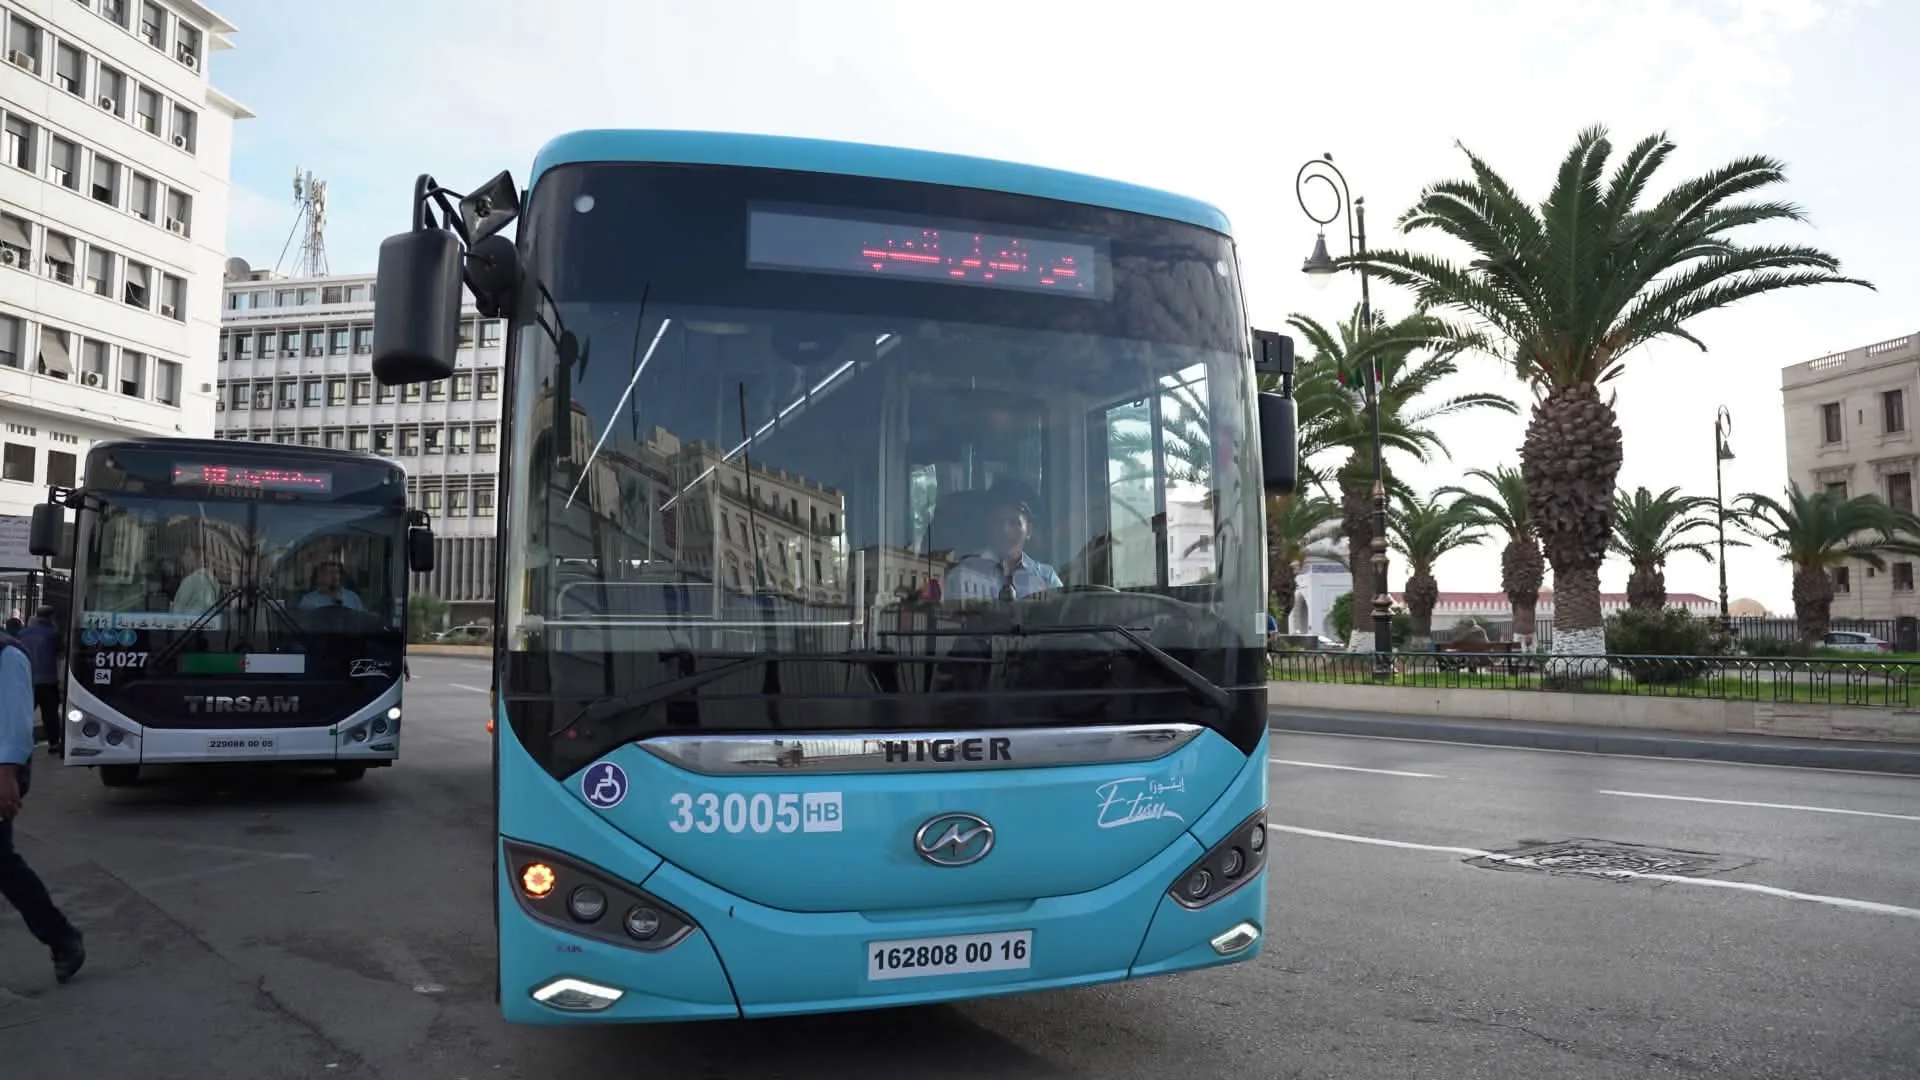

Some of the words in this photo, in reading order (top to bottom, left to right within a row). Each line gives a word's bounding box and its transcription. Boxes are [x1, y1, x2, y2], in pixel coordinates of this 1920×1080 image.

[95, 652, 148, 667] 61027
[96, 671, 110, 682] SA
[184, 696, 299, 712] TIRSAM
[885, 737, 1012, 762] HIGER
[669, 793, 799, 833] 33005
[805, 799, 840, 824] HB
[874, 944, 958, 970] 162808
[965, 942, 992, 963] 00
[1001, 939, 1026, 960] 16
